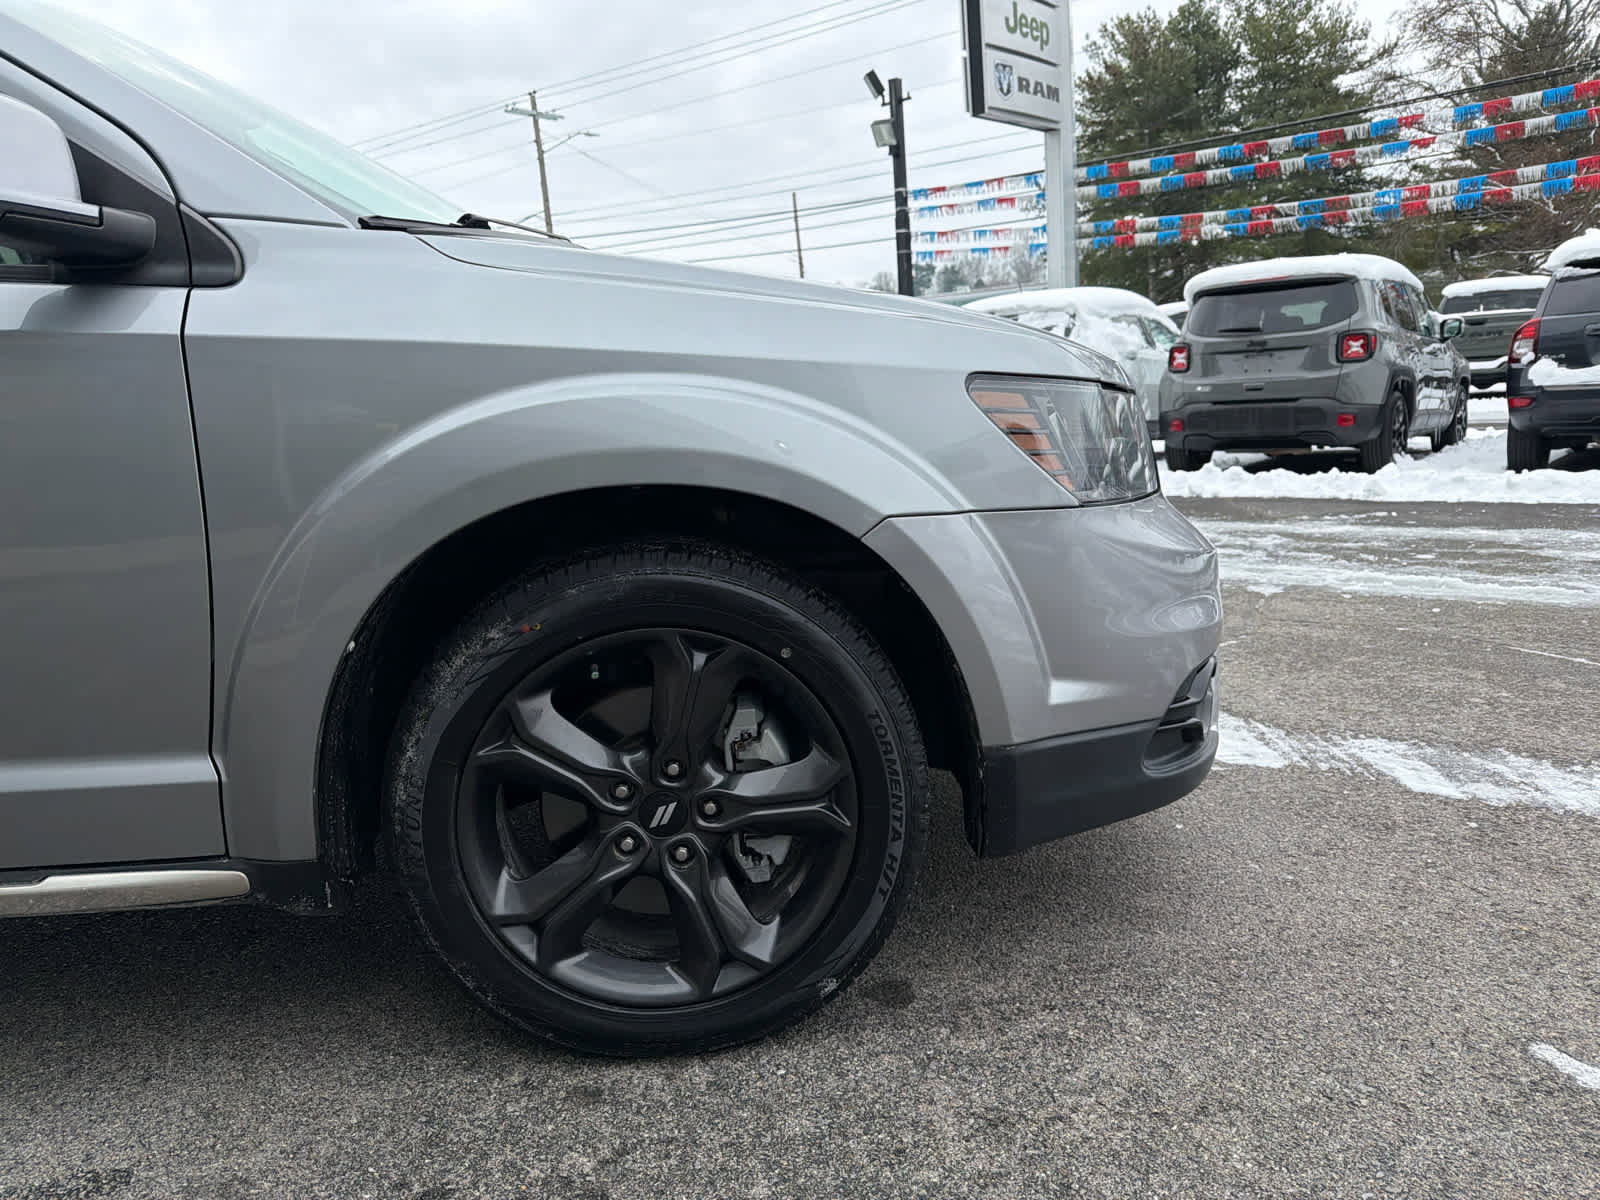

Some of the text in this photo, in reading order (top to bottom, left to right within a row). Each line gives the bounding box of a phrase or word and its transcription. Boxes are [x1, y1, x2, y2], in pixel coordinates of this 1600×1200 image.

[1004, 1, 1050, 51] Jeep
[1017, 76, 1060, 103] RAM
[868, 709, 904, 901] TORMENTA H/T
